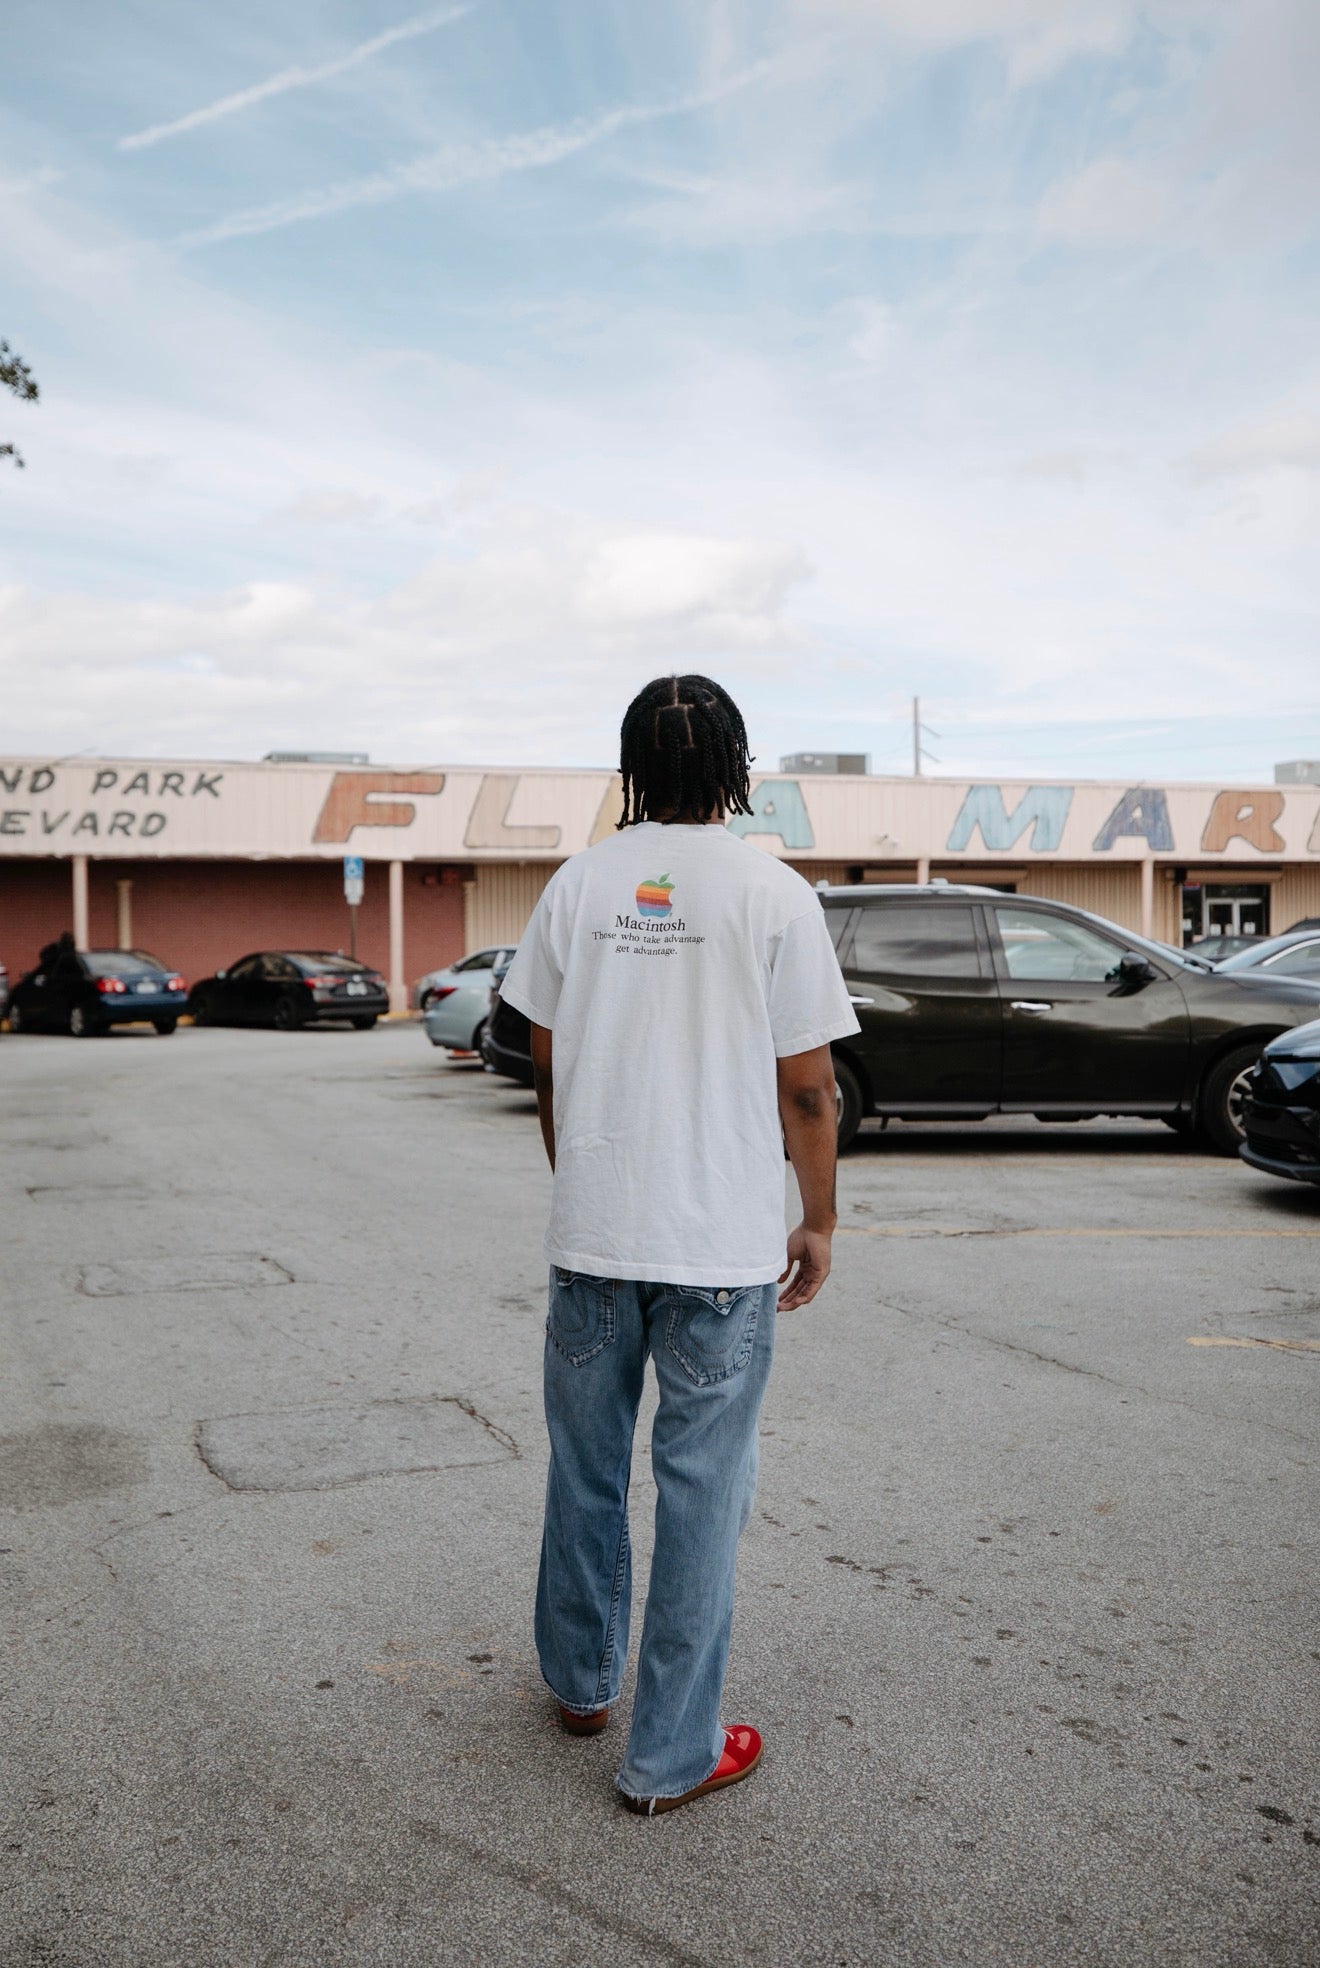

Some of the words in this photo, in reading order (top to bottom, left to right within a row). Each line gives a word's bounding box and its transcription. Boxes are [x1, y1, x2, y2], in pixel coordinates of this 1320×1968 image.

[91, 770, 223, 797] PARK
[312, 772, 816, 849] FLA
[945, 785, 1320, 853] MAR
[616, 915, 686, 932] Macintosh
[592, 931, 617, 941] Those
[621, 932, 640, 942] who
[643, 935, 661, 944] take
[664, 934, 706, 944] advantage
[615, 944, 630, 954] get
[633, 946, 678, 957] advantage.
